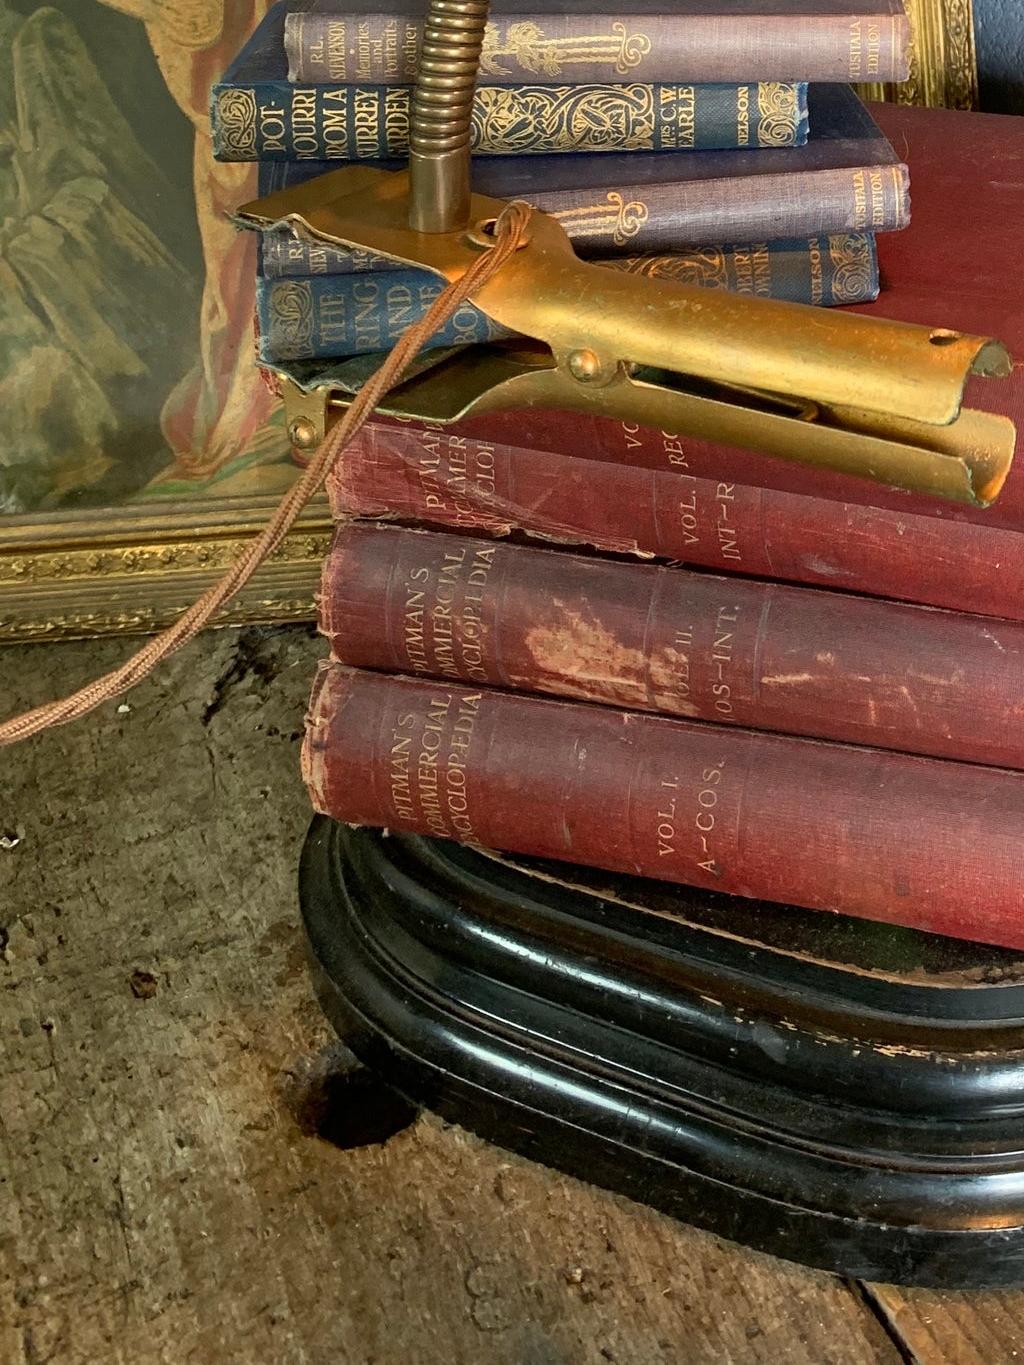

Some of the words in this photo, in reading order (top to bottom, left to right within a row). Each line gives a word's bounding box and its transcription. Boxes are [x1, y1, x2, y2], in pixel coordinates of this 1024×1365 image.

[310, 36, 324, 64] R.L.
[328, 21, 346, 80] STEVENSON
[356, 22, 371, 79] Memories
[370, 38, 383, 64] and
[384, 20, 398, 78] Portraits
[402, 23, 418, 64] other
[848, 21, 861, 77] TUSITALA
[867, 23, 880, 75] EDITION
[291, 88, 320, 160] POURRI
[323, 88, 347, 104] A
[354, 88, 380, 159] SURREY
[678, 86, 695, 148] EARLE
[737, 86, 749, 146] NELSON
[260, 100, 287, 152] POT-
[322, 108, 349, 160] FROM
[870, 172, 884, 226] EDITION
[733, 242, 753, 297] OBERT
[808, 238, 823, 305] NELSON
[320, 293, 346, 346] THE
[352, 281, 381, 350] RING
[680, 490, 700, 545] VOL.
[433, 548, 466, 679] OMMERCIAL
[391, 713, 418, 821] PITMAN'S
[418, 694, 452, 837] COMMERCIAL
[658, 798, 676, 856] VOL.
